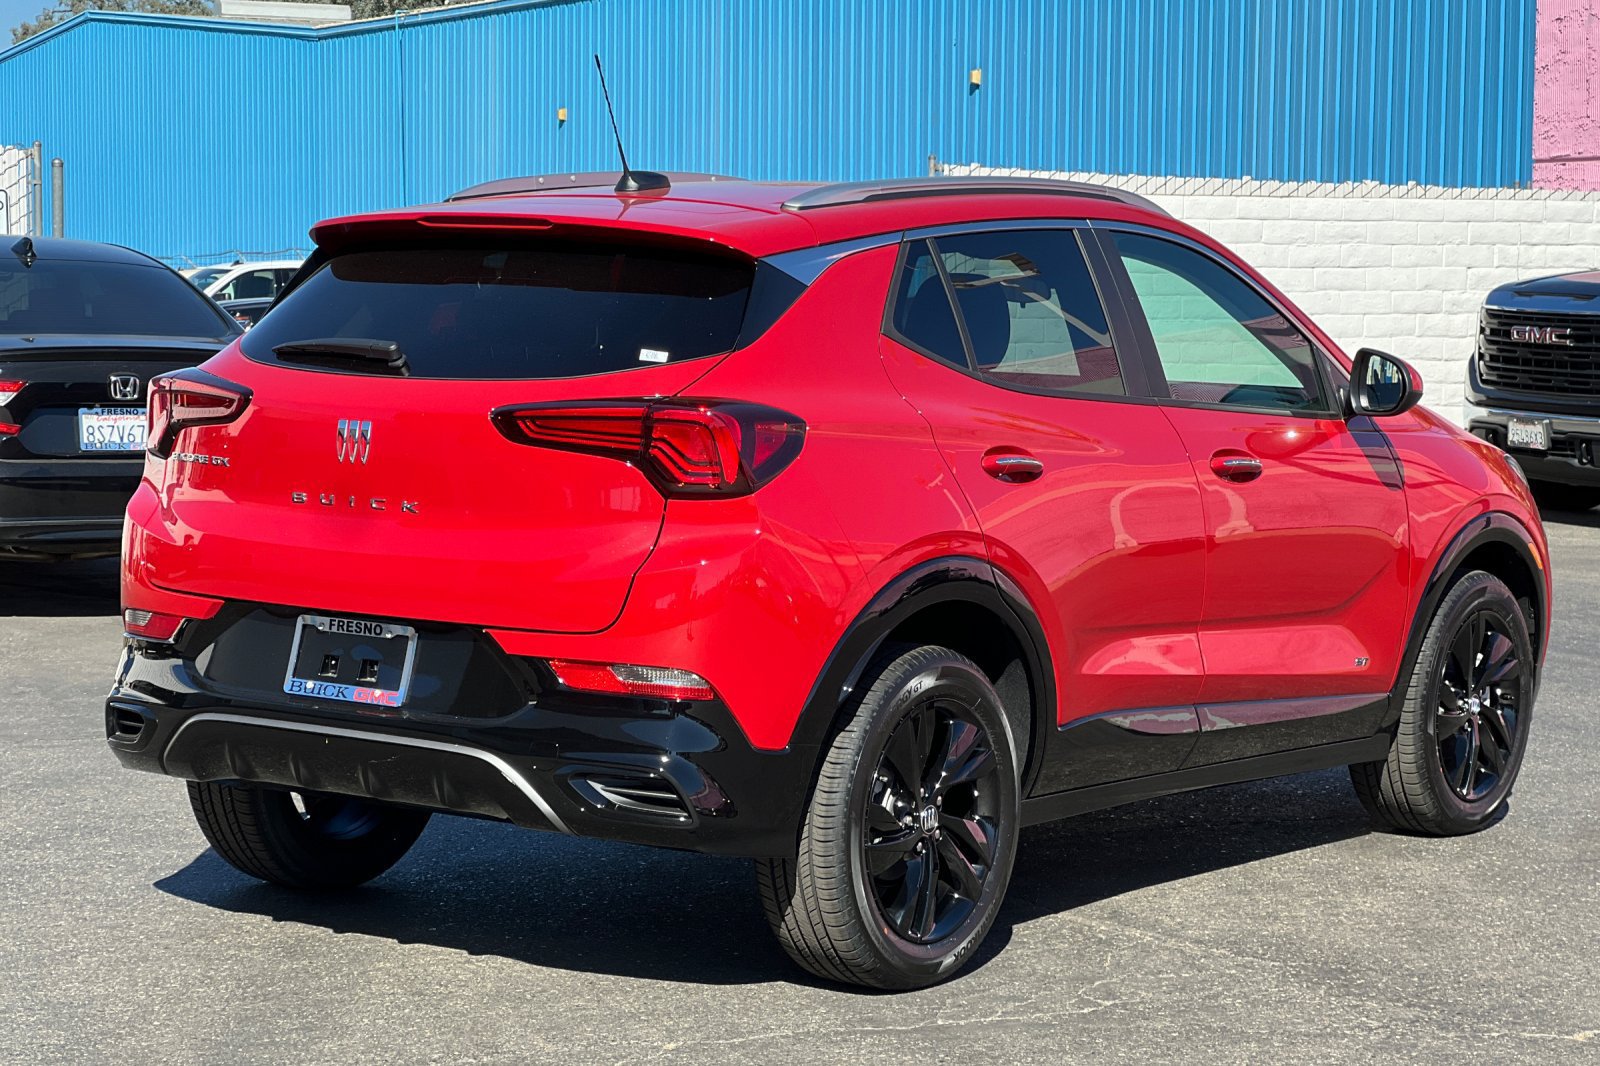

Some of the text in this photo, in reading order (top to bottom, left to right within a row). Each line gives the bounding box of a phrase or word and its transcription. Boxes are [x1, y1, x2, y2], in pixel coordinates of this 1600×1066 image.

[1511, 325, 1573, 346] GMC
[101, 408, 139, 416] FRESNO
[85, 442, 127, 450] BUICK
[211, 455, 231, 467] GX
[292, 491, 419, 514] BUICK
[329, 618, 383, 636] FRESNO
[289, 680, 399, 706] BUICK GMC
